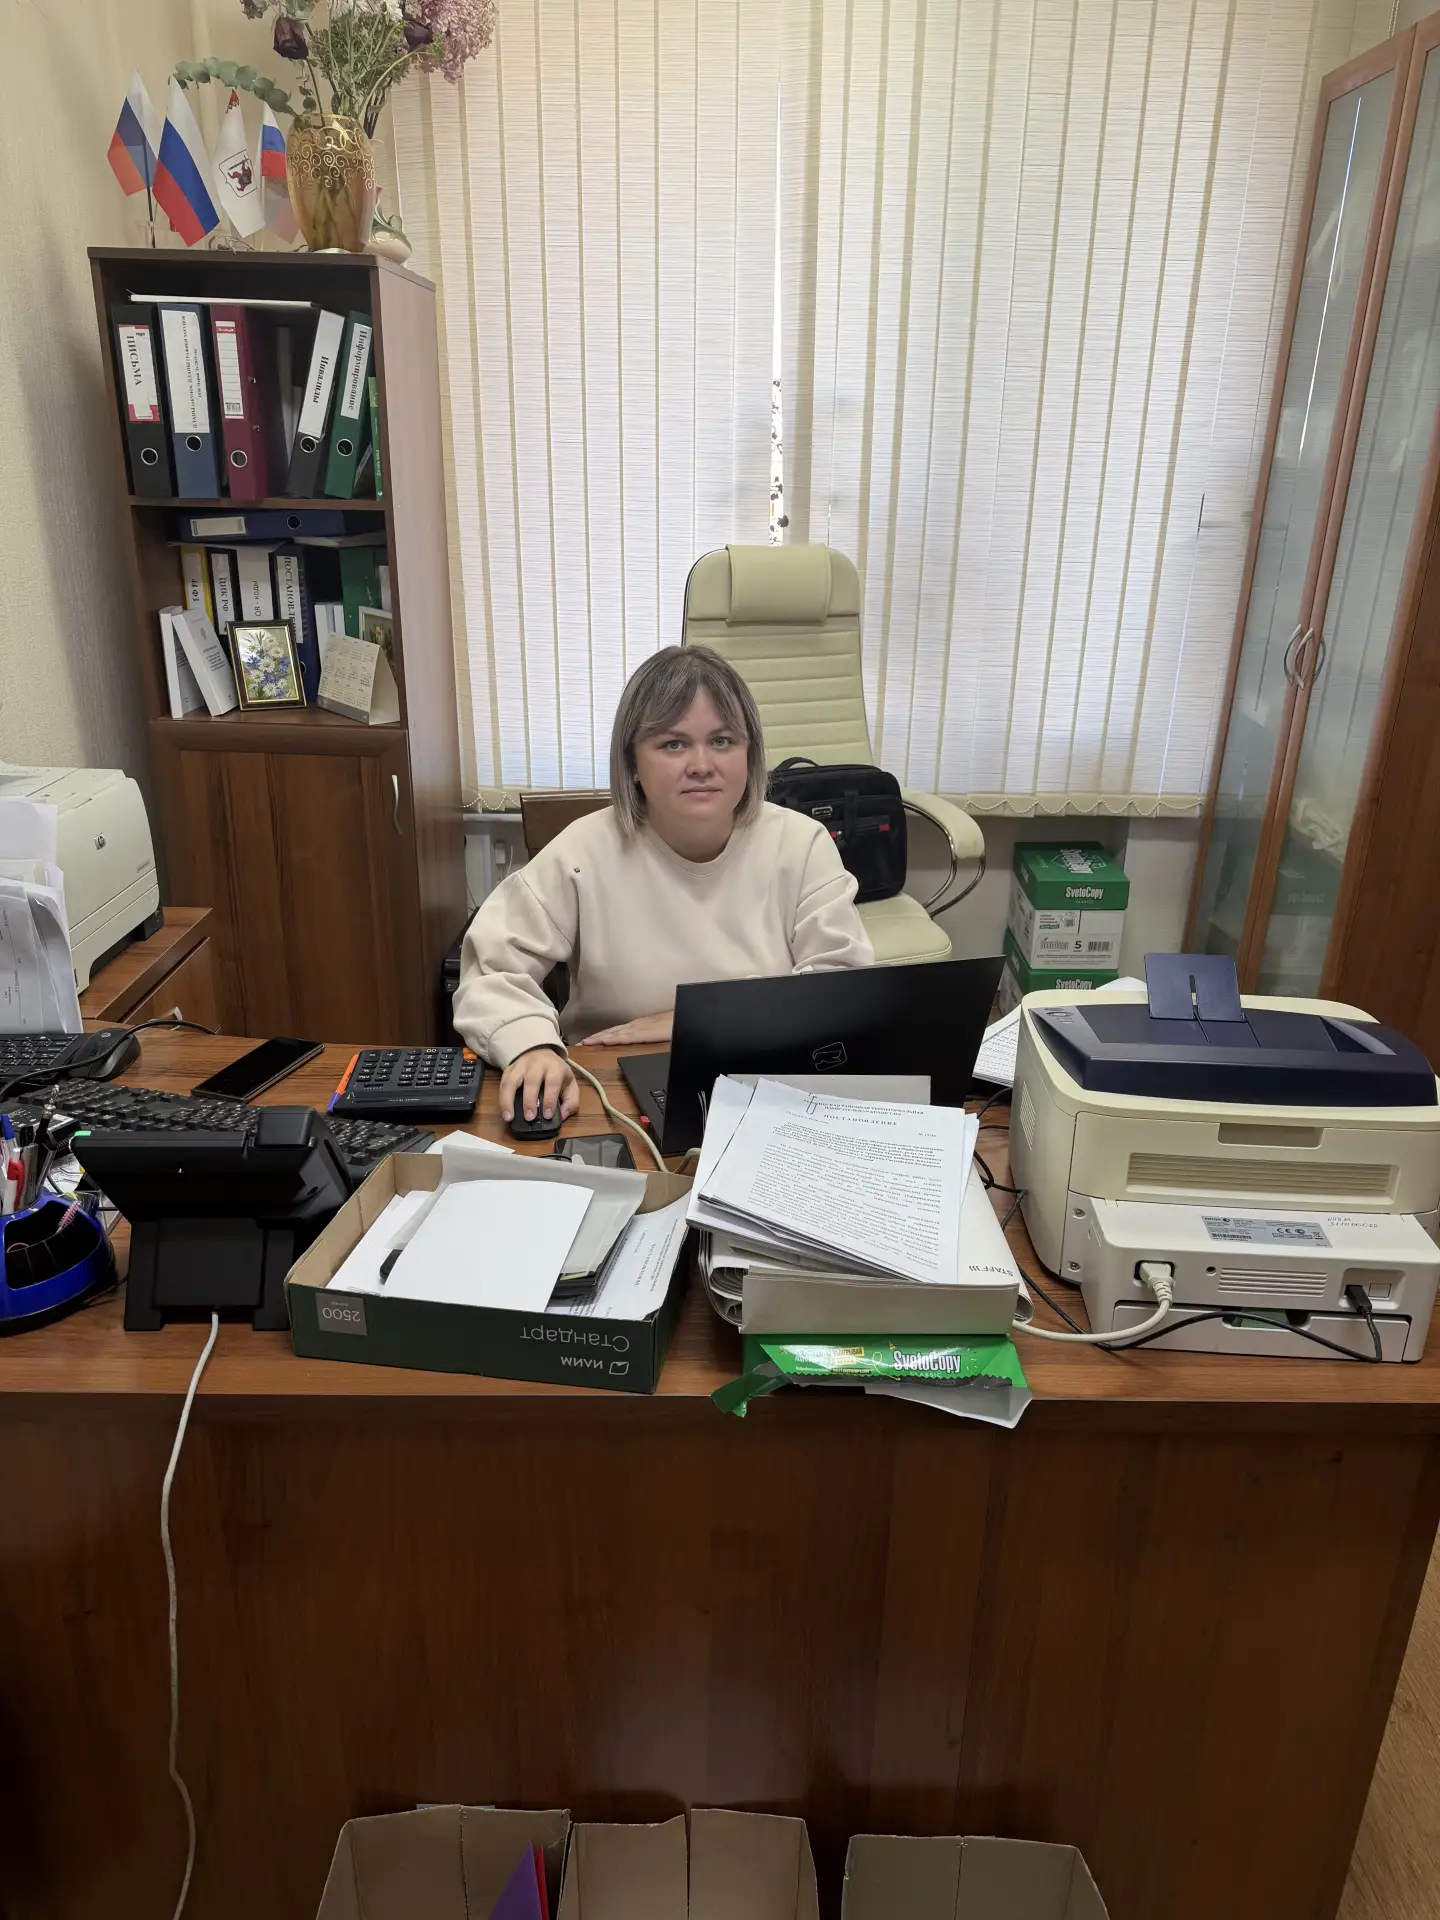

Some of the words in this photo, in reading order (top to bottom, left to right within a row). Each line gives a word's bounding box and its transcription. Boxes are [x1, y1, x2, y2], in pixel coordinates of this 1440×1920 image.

[126, 335, 143, 387] ПИСЬМА
[348, 329, 368, 410] Информирование
[312, 355, 329, 404] Инвалиды
[219, 577, 228, 597] ЦИК
[191, 589, 200, 602] ФЗ
[220, 598, 229, 612] РФ
[254, 605, 262, 616] QR
[1065, 887, 1104, 899] SvetoCopy
[1074, 941, 1082, 949] 5
[979, 1265, 1014, 1278] STAFF
[322, 1307, 361, 1323] 2500
[520, 1326, 630, 1353] Стандарт
[560, 1356, 604, 1370] илим
[893, 1350, 961, 1374] SvetoCopy
